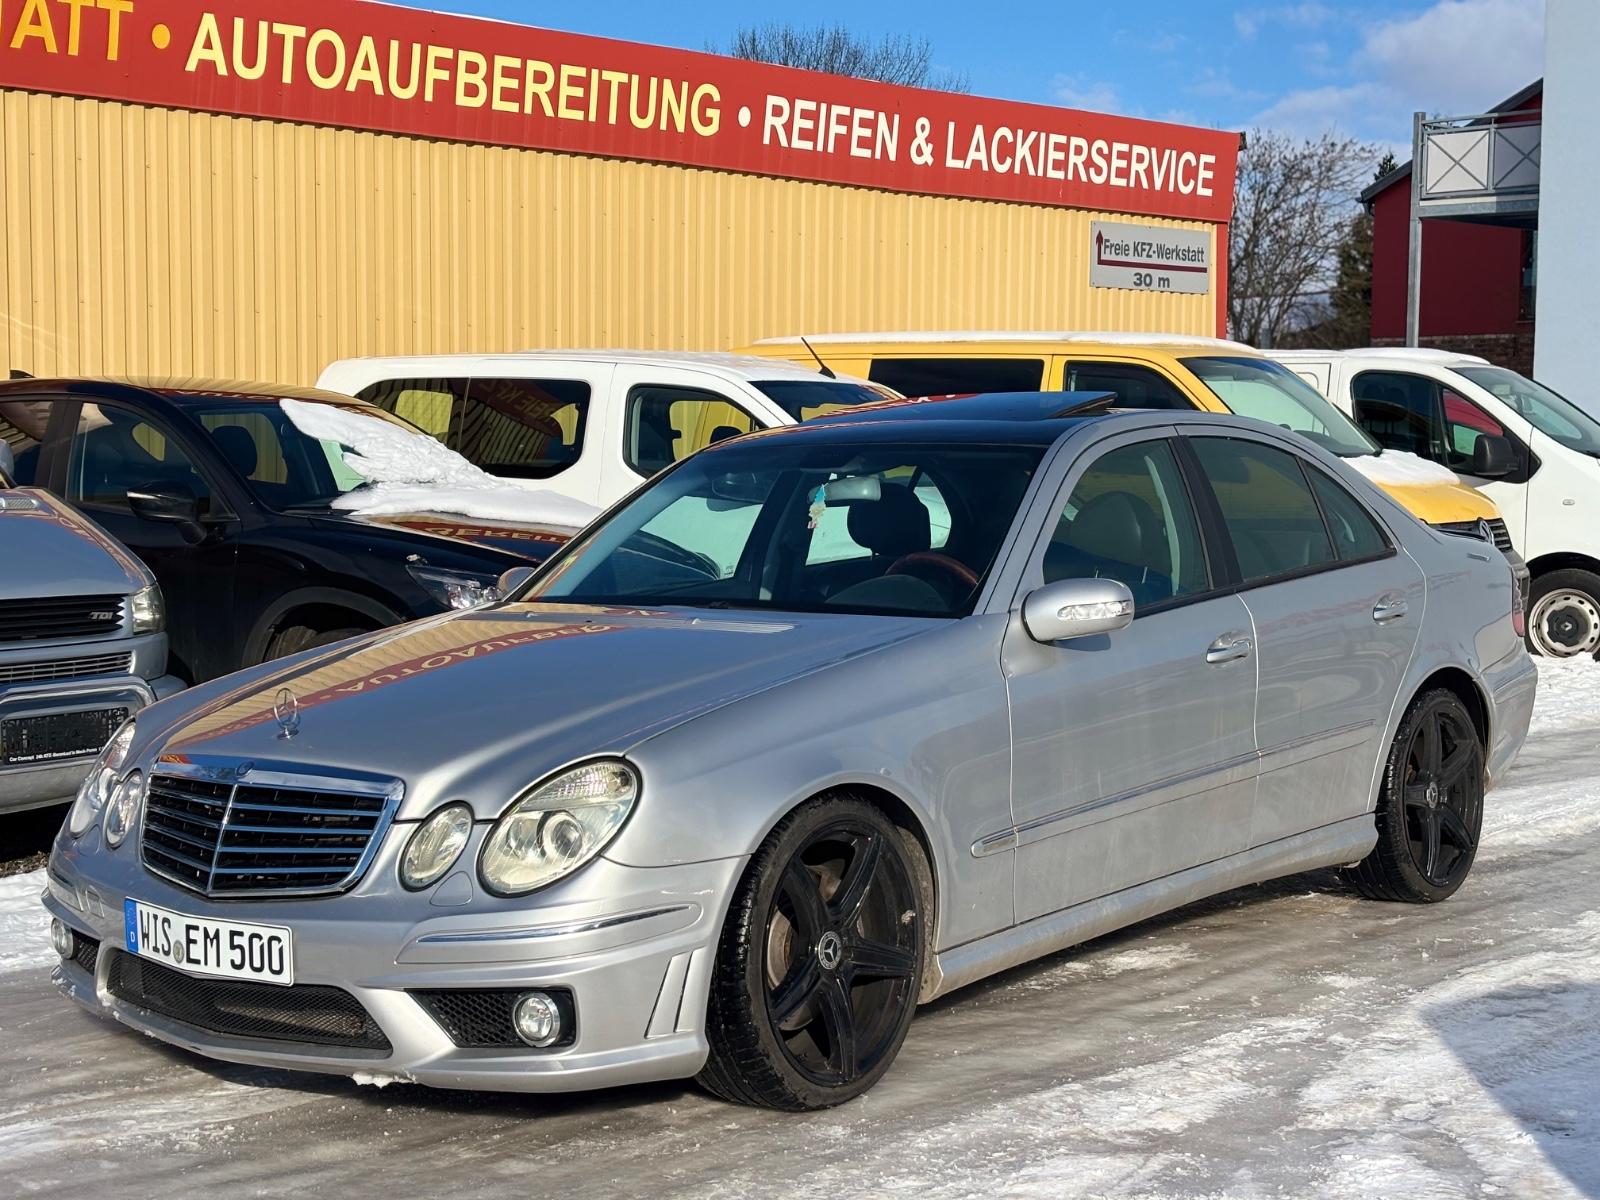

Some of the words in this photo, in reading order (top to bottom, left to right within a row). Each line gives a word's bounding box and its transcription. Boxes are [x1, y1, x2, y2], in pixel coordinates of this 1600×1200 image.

[0, 0, 134, 61] ATT
[185, 12, 721, 137] AUTOAUFBEREITUNG
[763, 95, 900, 162] REIFEN
[910, 117, 934, 166] &
[945, 121, 1216, 197] LACKIERSERVICE
[1103, 238, 1130, 257] Freie
[1133, 240, 1205, 263] KFZ-Werkstatt
[1133, 272, 1153, 288] 30
[1158, 276, 1170, 288] m
[130, 932, 136, 943] D
[139, 910, 171, 957] WIS
[185, 924, 221, 968] EM
[229, 930, 284, 975] 500
